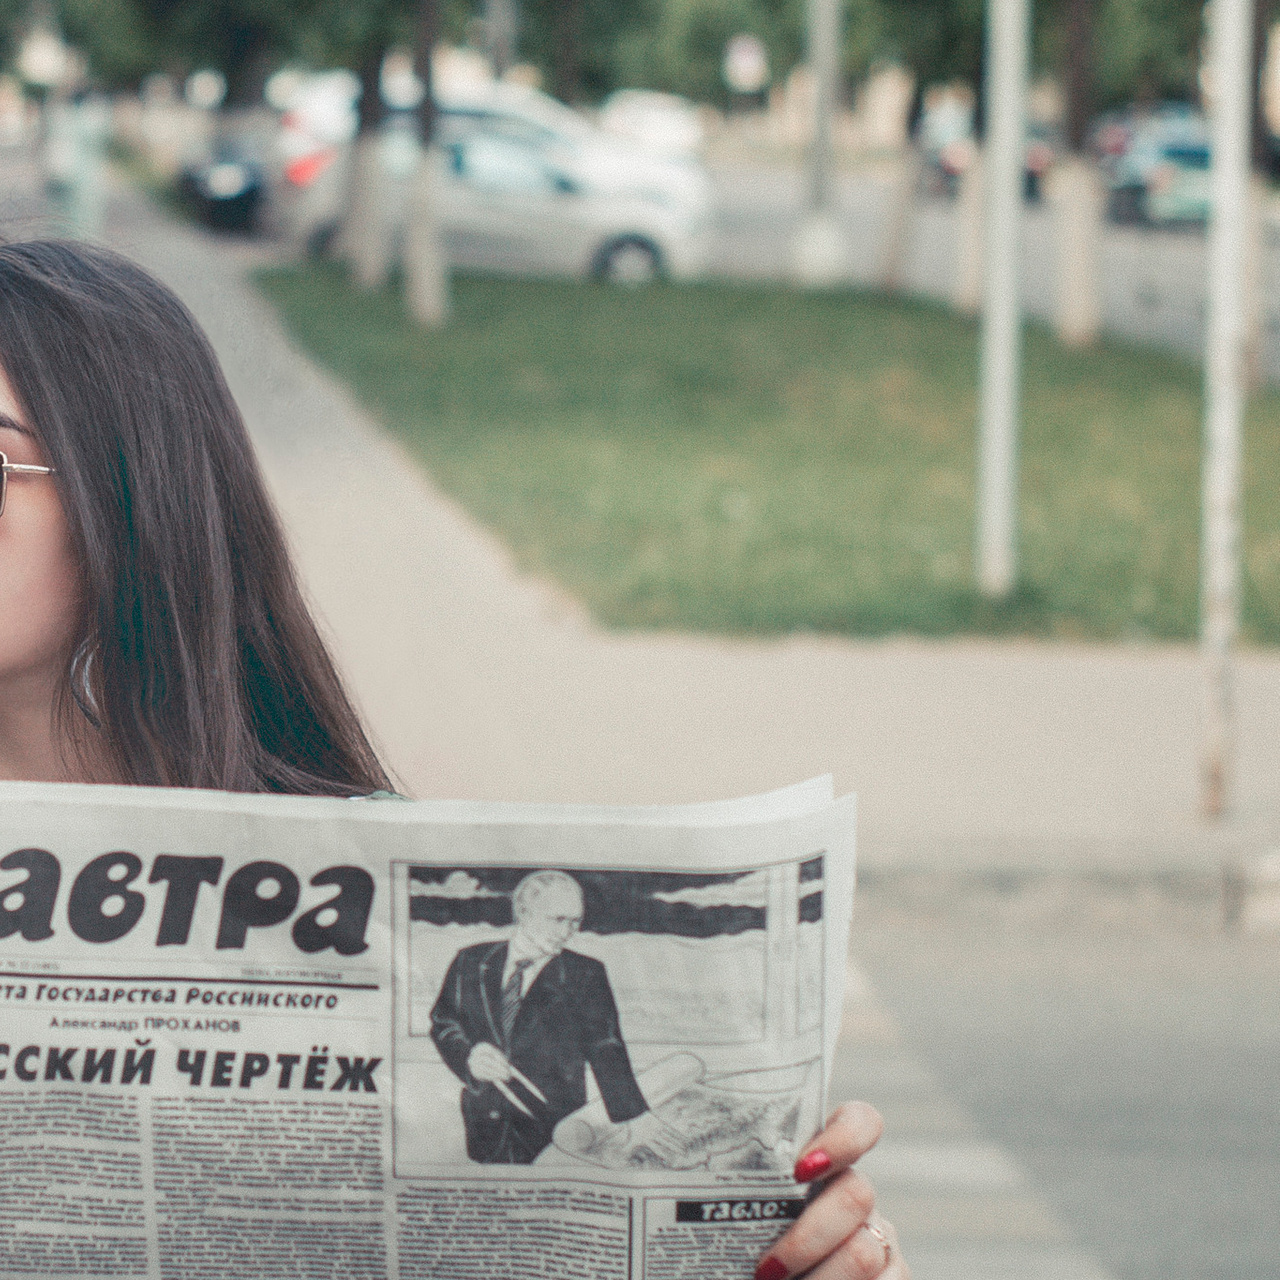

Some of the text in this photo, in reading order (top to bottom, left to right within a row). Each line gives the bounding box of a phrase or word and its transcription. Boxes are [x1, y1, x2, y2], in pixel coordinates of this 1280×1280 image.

[34, 983, 177, 1004] Государства
[49, 1016, 241, 1033] Александр ПРОХАНОВ
[175, 1045, 384, 1094] ЧЕРТЁЖ
